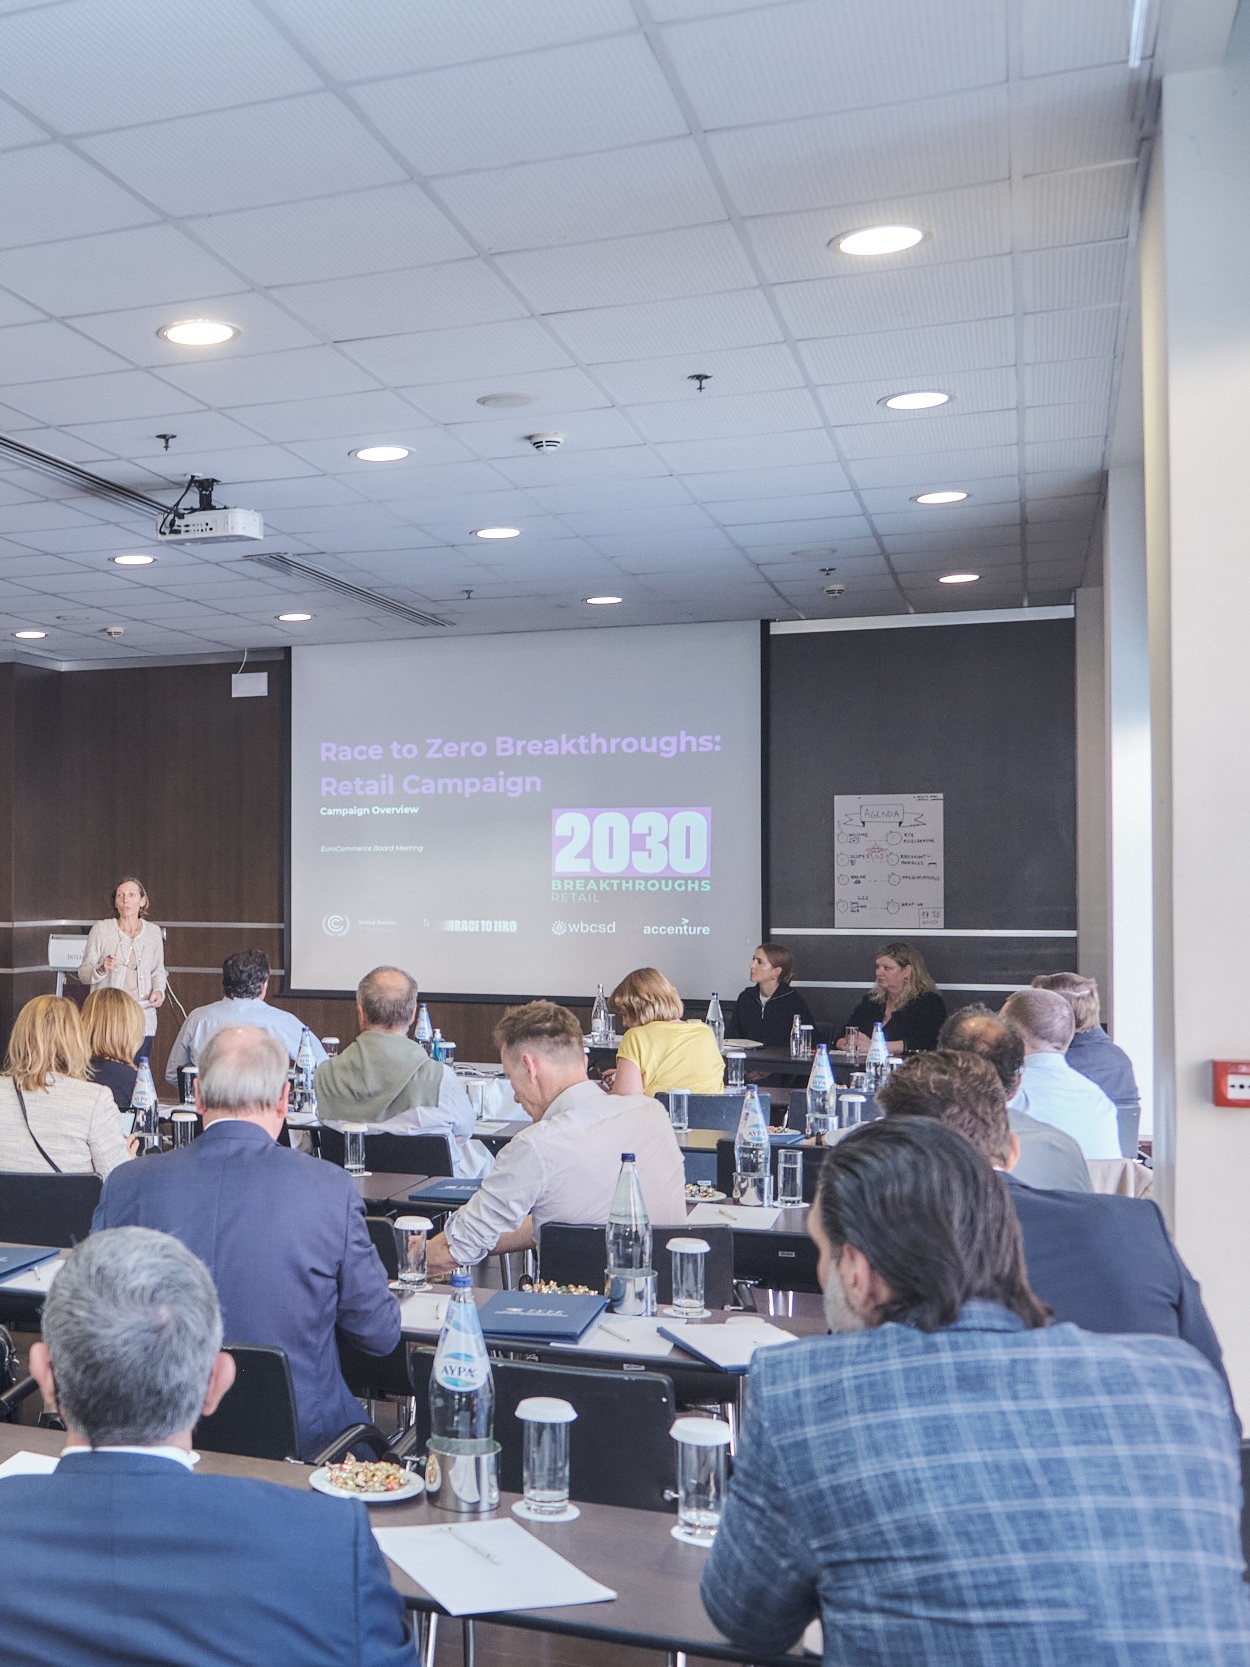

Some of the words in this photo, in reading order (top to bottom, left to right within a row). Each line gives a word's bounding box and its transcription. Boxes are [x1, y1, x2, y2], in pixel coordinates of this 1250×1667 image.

[320, 742, 384, 762] Race
[389, 740, 419, 760] to
[425, 738, 487, 759] Zero
[495, 730, 722, 758] Breakthroughs:
[320, 774, 395, 796] Retail
[402, 770, 542, 798] Campaign
[319, 805, 370, 817] Campaign
[371, 804, 420, 815] Overview
[864, 808, 900, 819] AGENDA
[373, 844, 395, 852] Board
[555, 810, 708, 874] 2030
[551, 879, 711, 892] BREAKTHROUGHS
[551, 892, 600, 903] RETAIL
[454, 919, 480, 932] RACE
[481, 919, 493, 932] TO
[493, 920, 518, 933] ZERO
[568, 921, 616, 934] wbcsd
[643, 922, 710, 935] accenture
